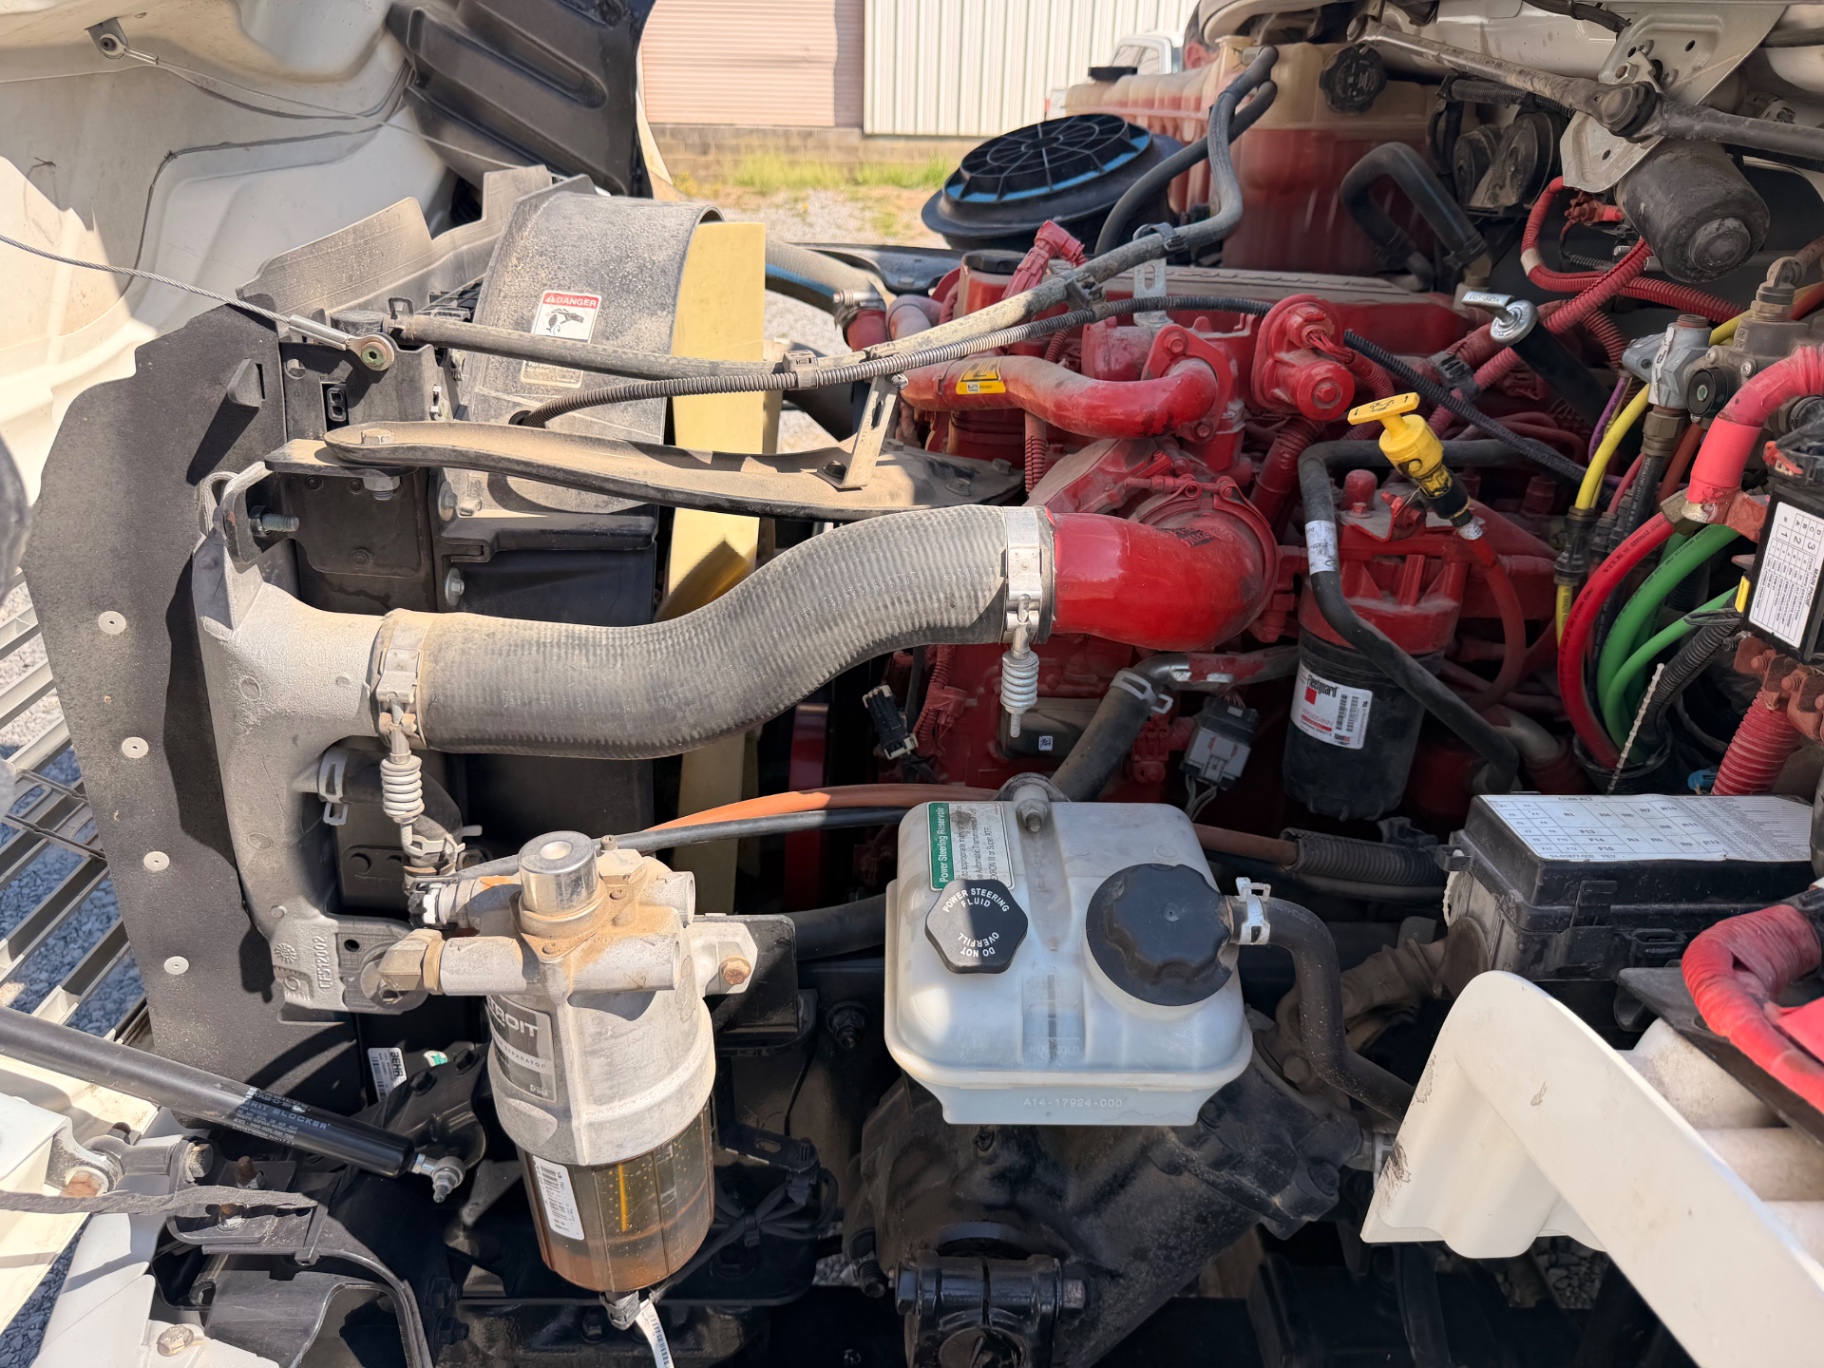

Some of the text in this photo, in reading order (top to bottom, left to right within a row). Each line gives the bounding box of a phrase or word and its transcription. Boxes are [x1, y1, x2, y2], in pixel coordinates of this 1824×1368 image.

[556, 296, 597, 308] DANGER
[1794, 535, 1802, 544] 2
[1306, 674, 1338, 698] Fleetguard
[936, 806, 948, 883] Power Steering Reservoir
[986, 836, 995, 849] Super
[943, 888, 1009, 912] POWER STEERING
[961, 897, 990, 908] FLUID
[958, 932, 999, 948] OVERFILL
[960, 946, 996, 957] DO NOT
[390, 1052, 403, 1077] BEHR
[1023, 1098, 1122, 1108] A14-17924-000
